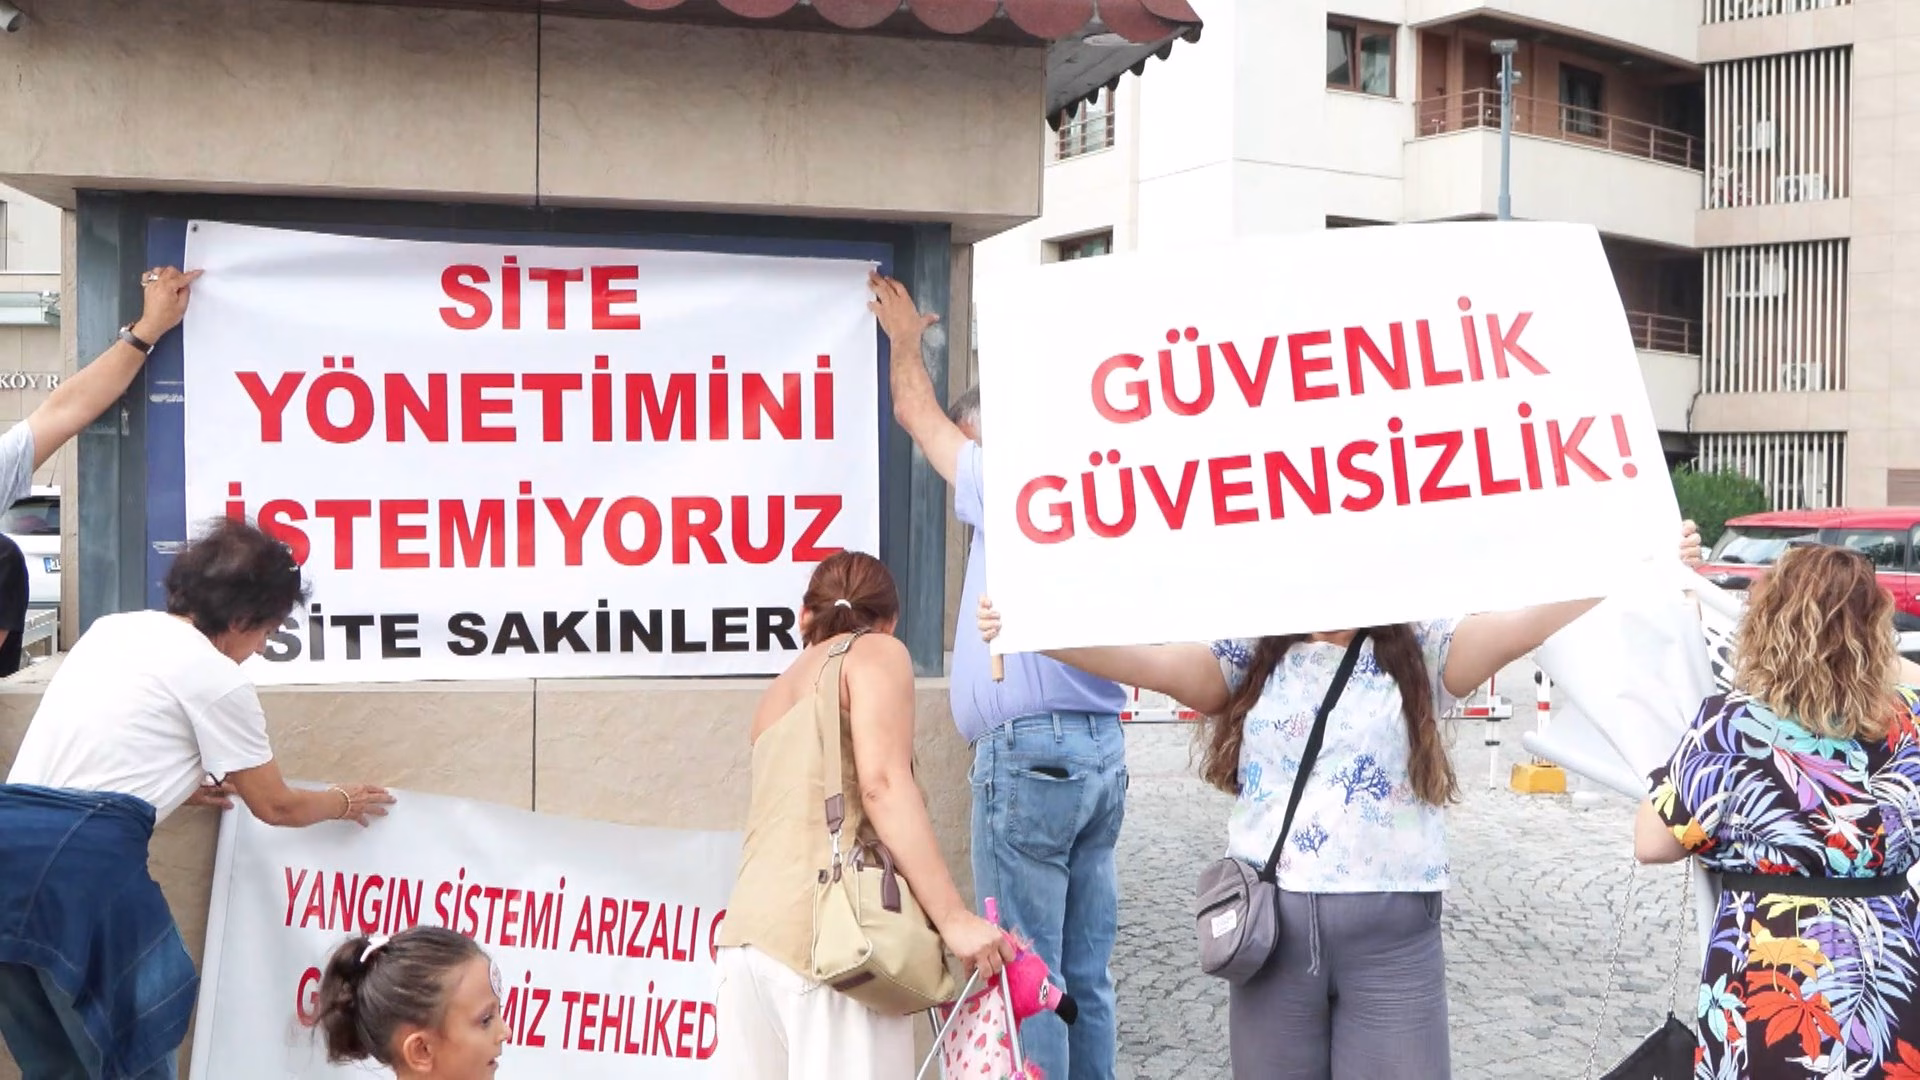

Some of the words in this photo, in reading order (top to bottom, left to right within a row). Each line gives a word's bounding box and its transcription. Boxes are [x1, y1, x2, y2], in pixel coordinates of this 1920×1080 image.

[439, 255, 641, 331] SİTE
[235, 354, 835, 445] YÖNETİMİNİ
[1091, 297, 1551, 424] GÜVENLİK
[1015, 402, 1640, 545] GÜVENSİZLİK!
[262, 603, 422, 662] SİTE
[447, 598, 808, 657] SAKİNLER
[285, 867, 424, 935] YANGIN
[434, 867, 565, 950] SİSTEMİ
[569, 895, 701, 963] ARIZALI
